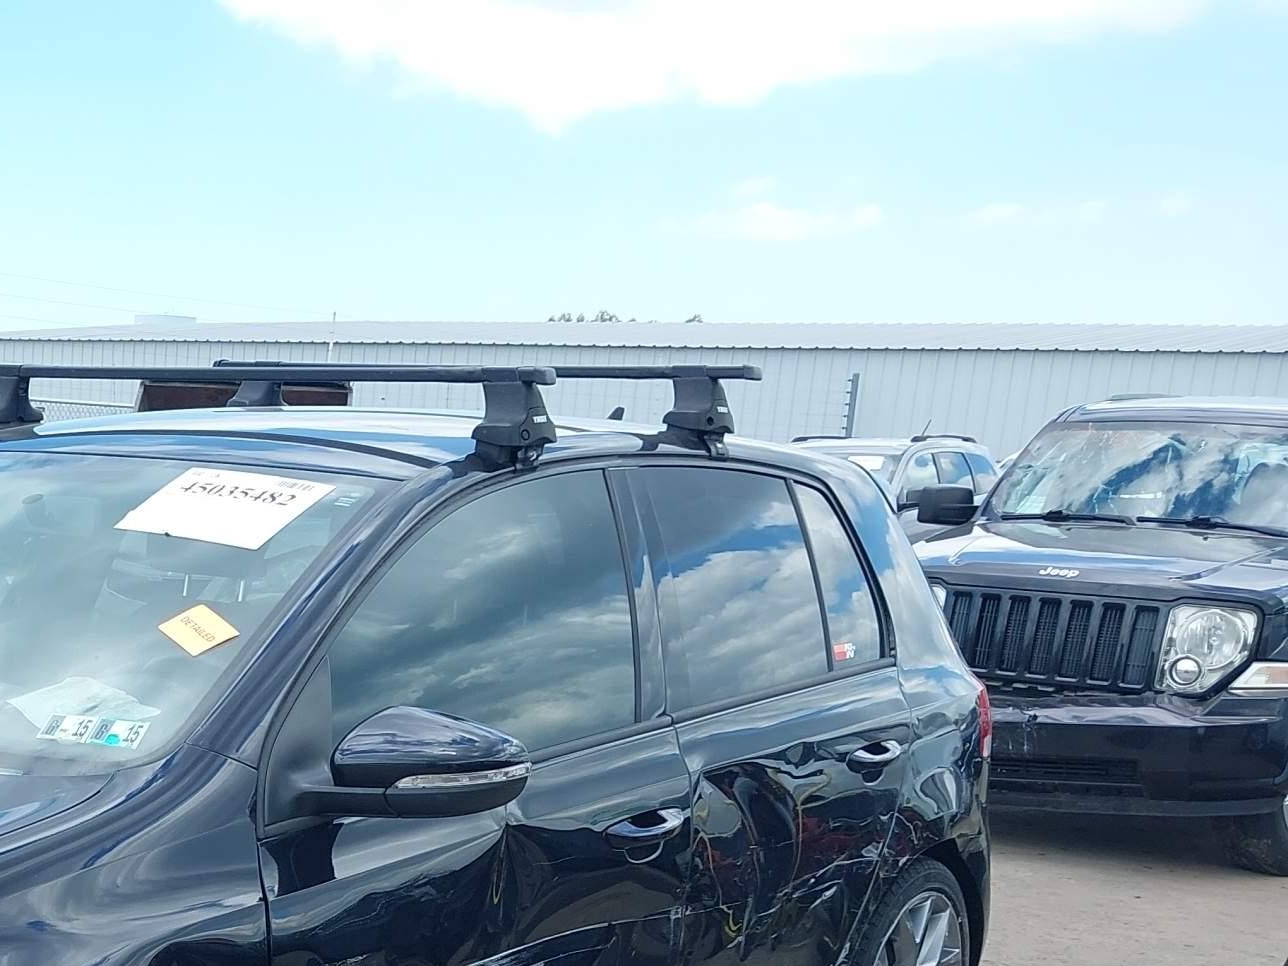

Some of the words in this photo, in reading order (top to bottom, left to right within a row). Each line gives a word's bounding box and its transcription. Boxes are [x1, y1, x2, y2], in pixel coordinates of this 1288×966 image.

[180, 482, 297, 506] 45035482
[1039, 566, 1080, 578] Jeep
[71, 719, 94, 737] 15
[122, 724, 144, 743] 15
